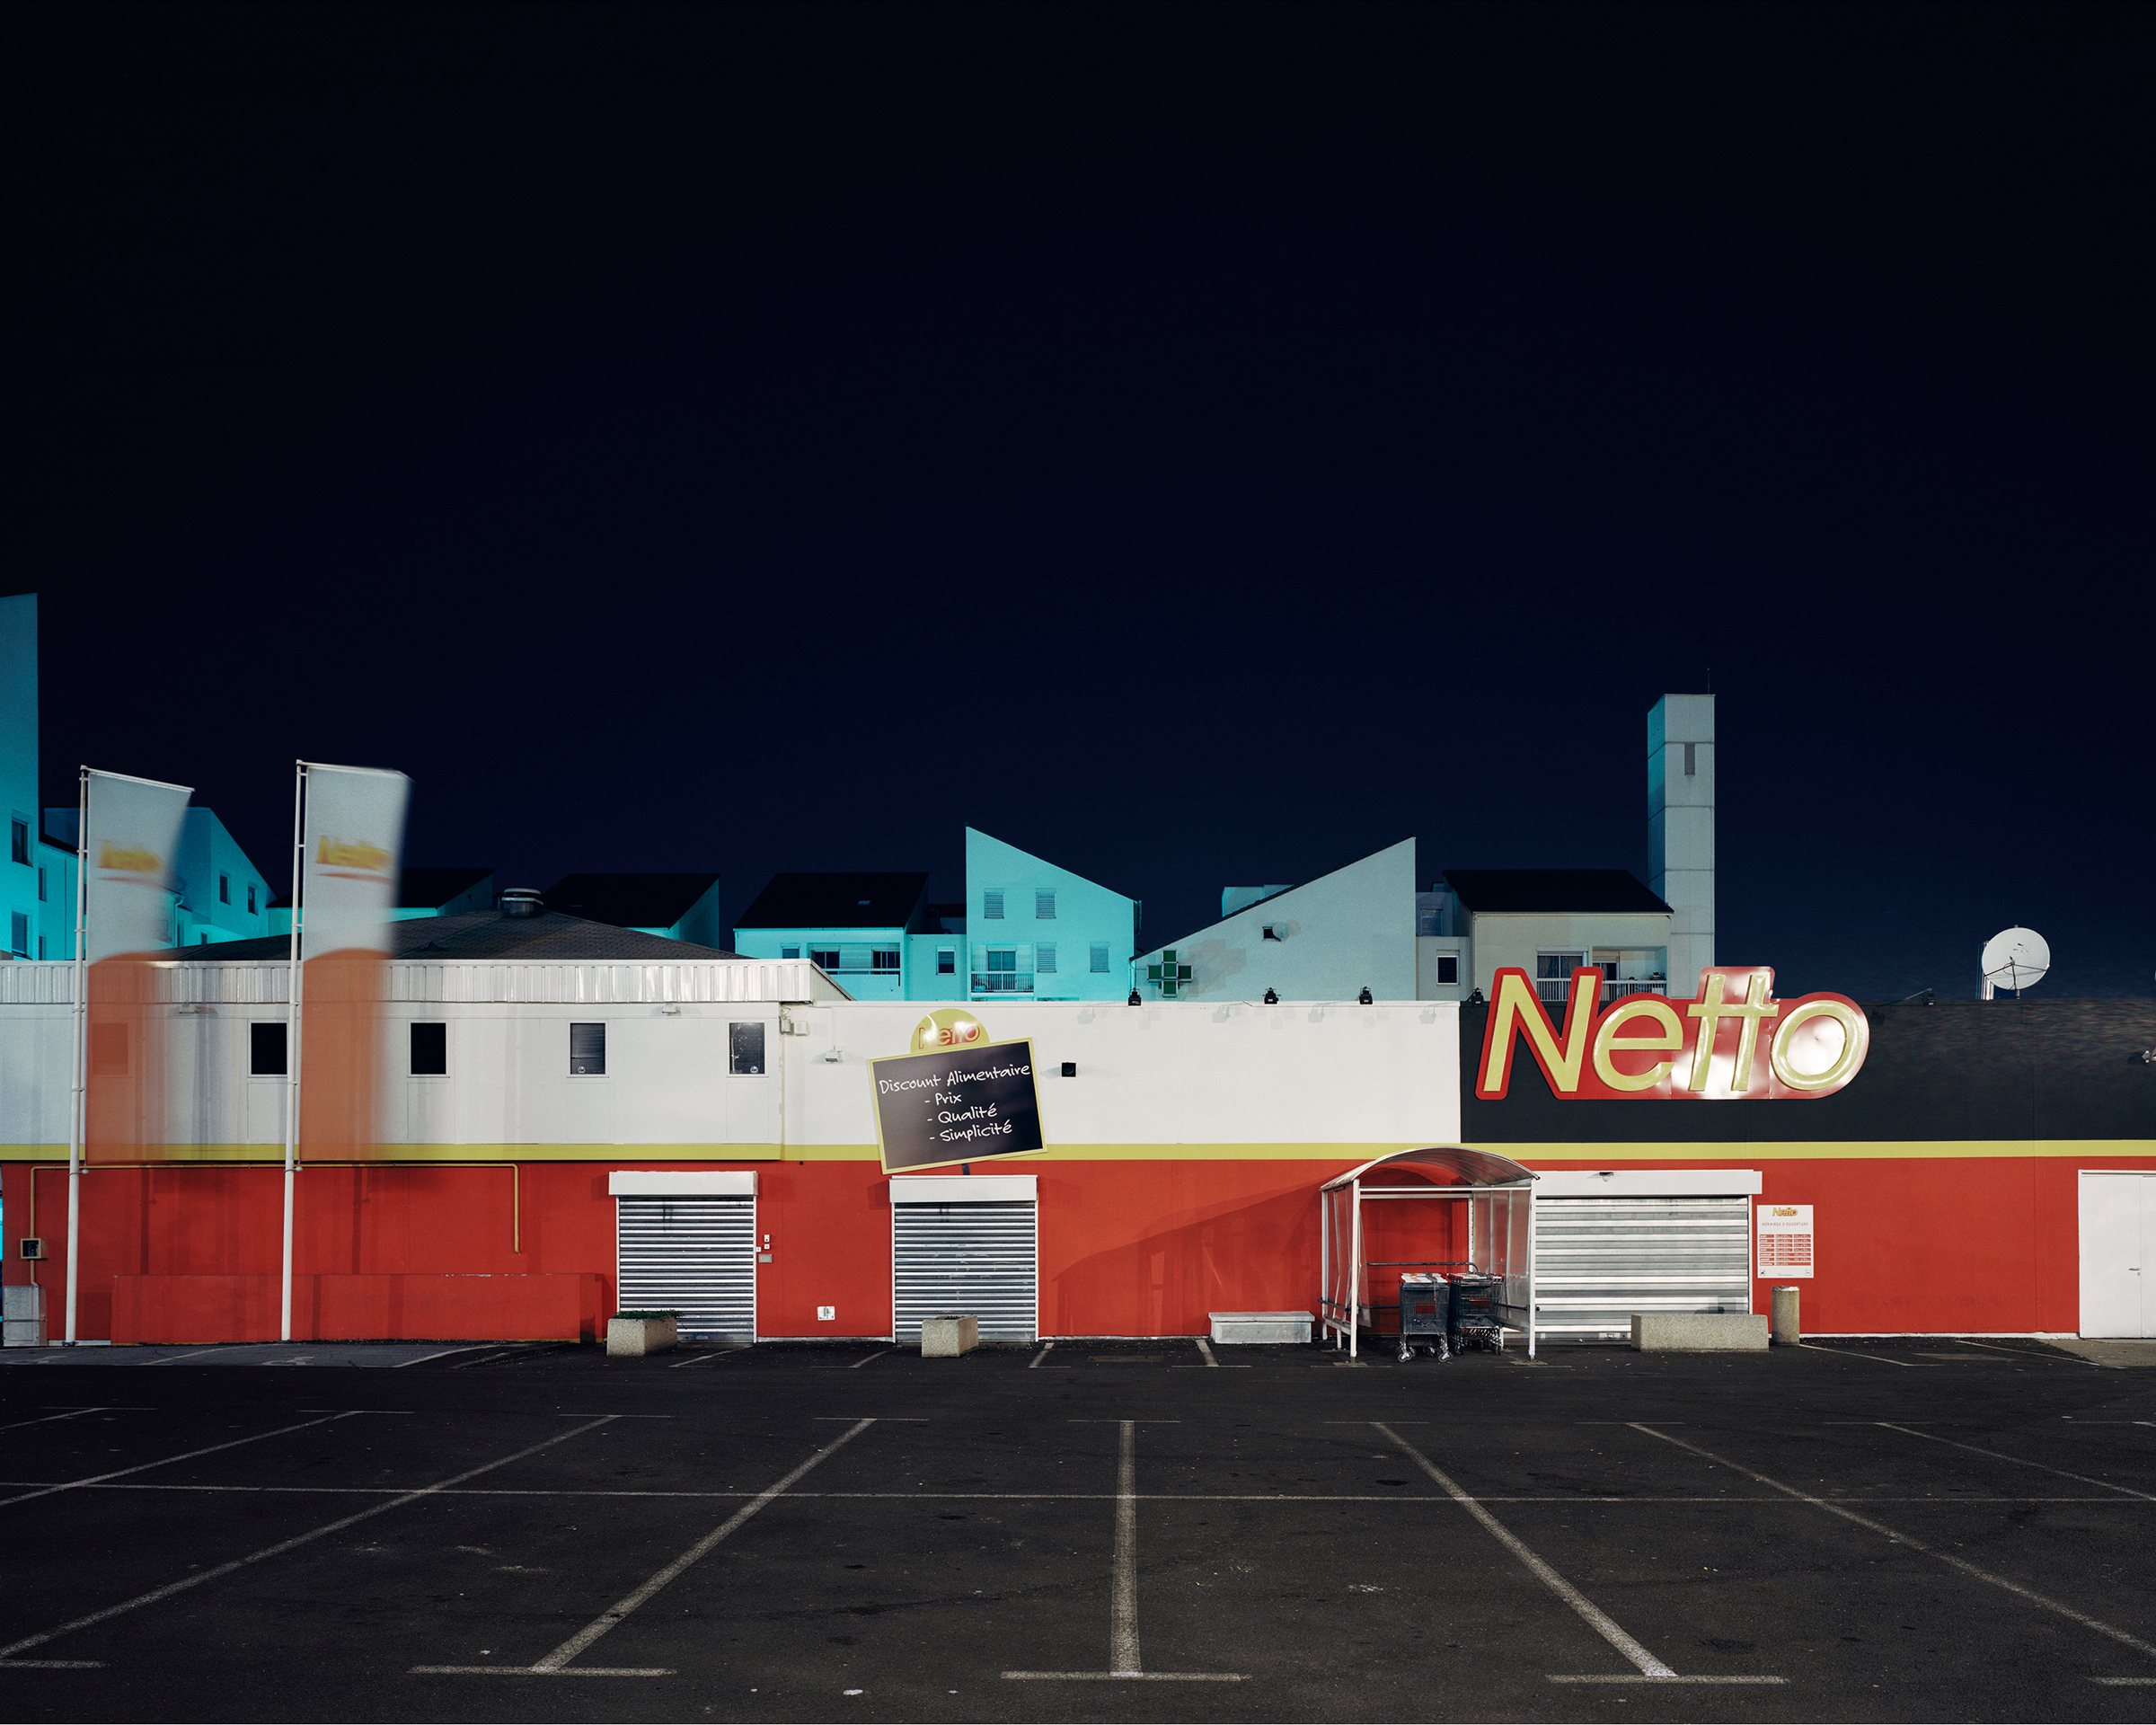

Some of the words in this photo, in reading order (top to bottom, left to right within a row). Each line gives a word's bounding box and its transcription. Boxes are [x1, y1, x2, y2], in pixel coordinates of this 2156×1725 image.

[1482, 973, 1864, 1092] Netto
[879, 1074, 941, 1094] Discount
[947, 1064, 1031, 1087] Alimentaire
[935, 1092, 962, 1106] Prix
[938, 1102, 997, 1124] Qualité
[940, 1119, 1012, 1142] Simplicité
